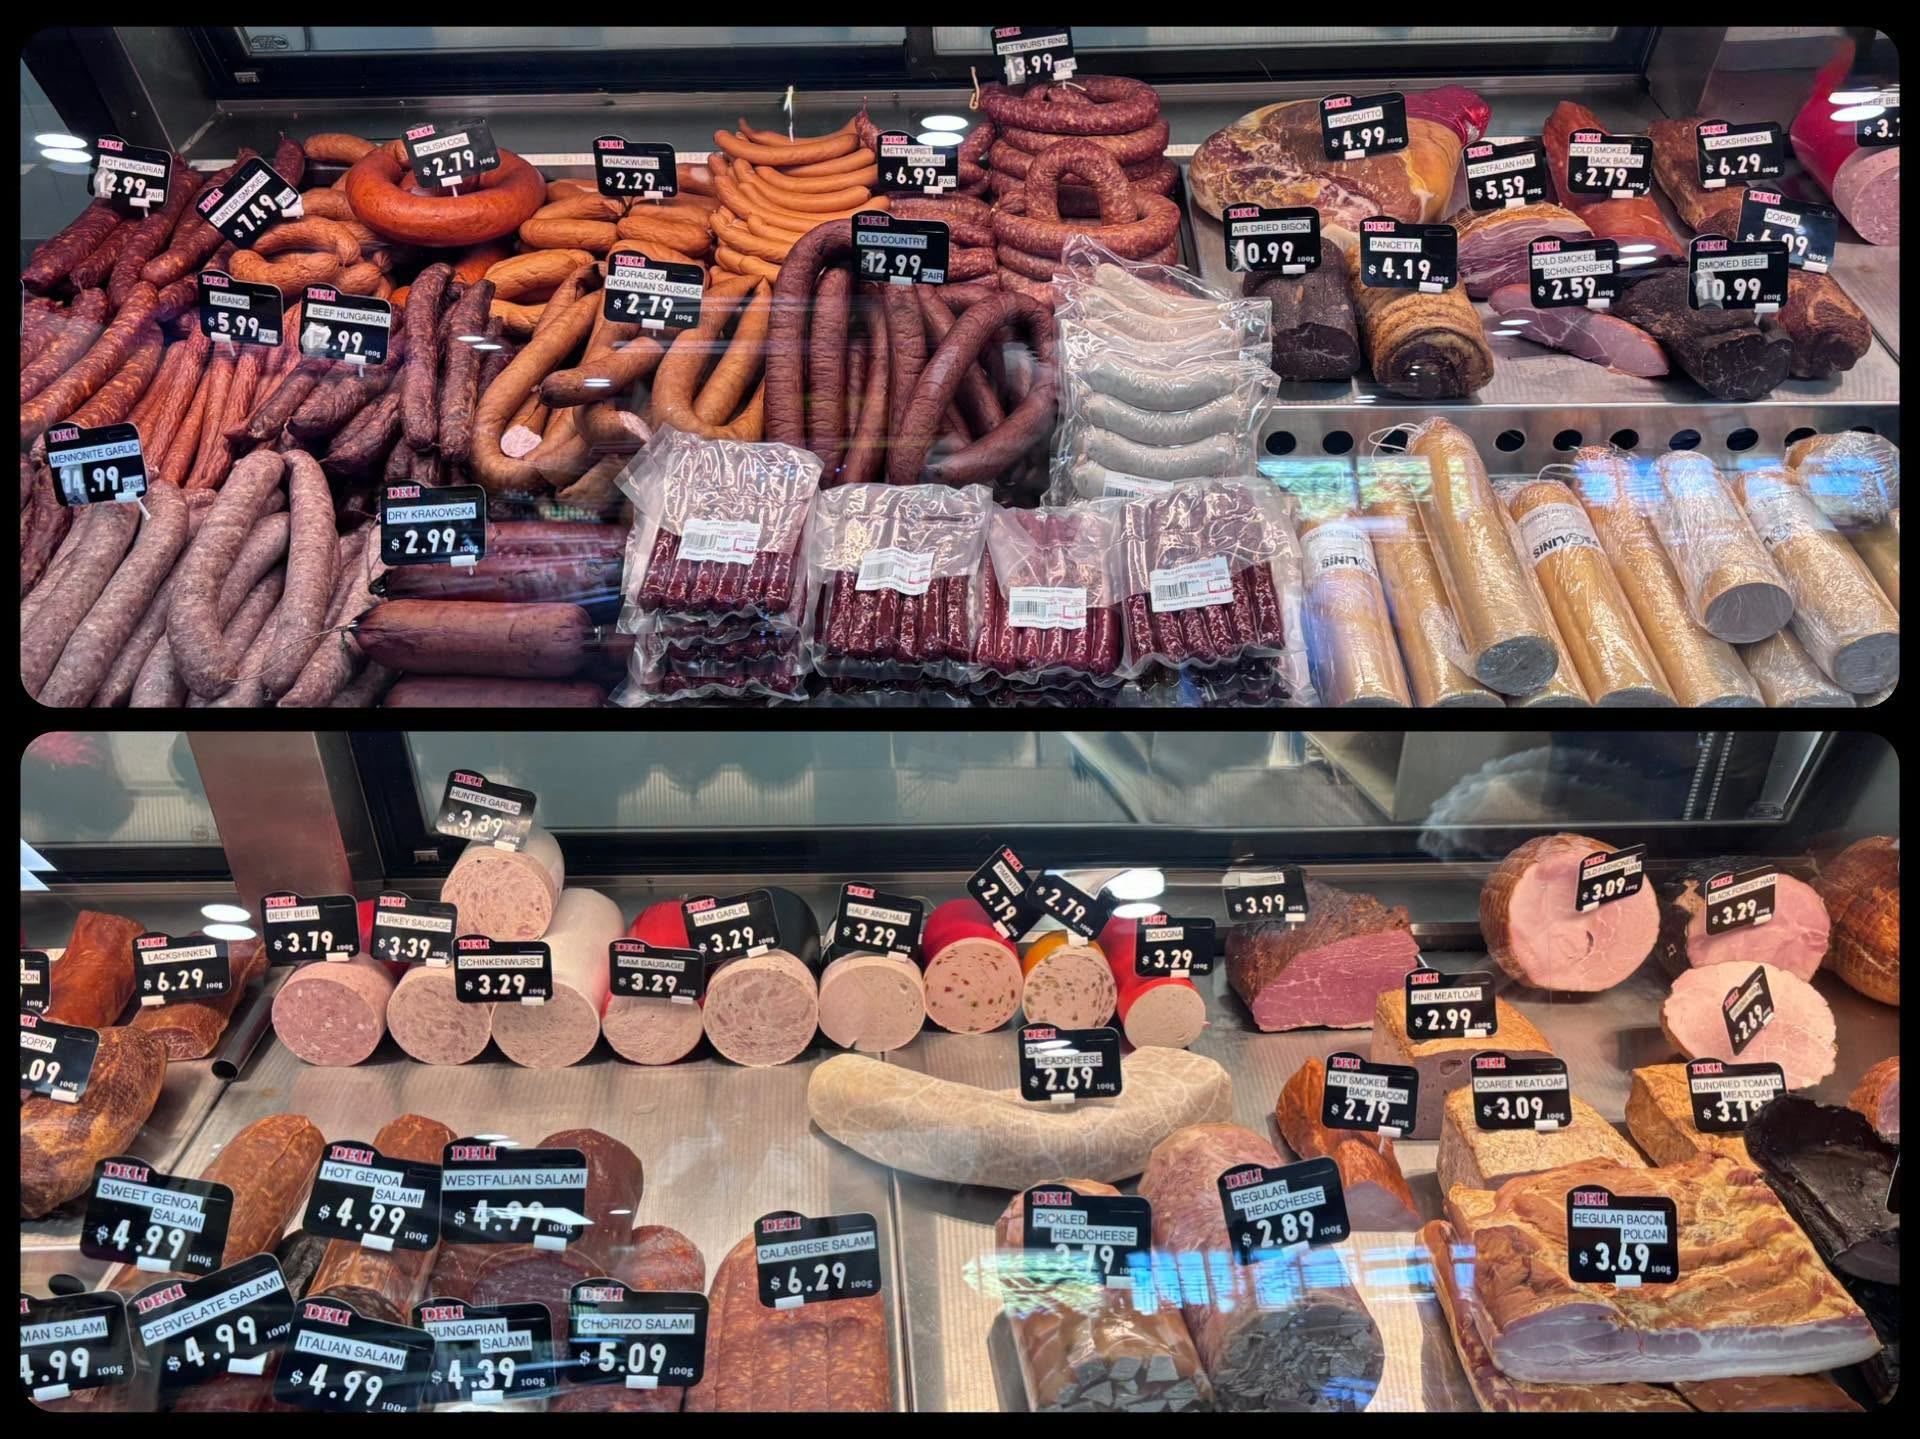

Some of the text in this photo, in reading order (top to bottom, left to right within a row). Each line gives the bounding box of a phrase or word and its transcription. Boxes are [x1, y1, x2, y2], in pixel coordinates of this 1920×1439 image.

[999, 35, 1067, 51] METTWURST RING
[416, 137, 466, 153] POLISH COIL
[1710, 135, 1767, 148] LACKSHINKEN
[604, 158, 658, 167] KNACKWURST
[909, 156, 944, 164] SMOKIES
[1469, 157, 1533, 175] WESTFALIAN HAM
[1590, 156, 1641, 165] BACK BACON
[118, 161, 163, 175] HUNGARIAN
[213, 172, 267, 223] HUNTER SMOKIES
[1766, 210, 1798, 225] COPPA
[1233, 223, 1310, 233] AIR DRIED BISON
[859, 234, 926, 245] OLD COUNTRY
[1371, 241, 1420, 249] PANCETTA
[1533, 253, 1596, 267] COLD SMOKED
[1699, 259, 1766, 270] SMOKED BEEF
[617, 270, 666, 281] GORALSKA
[922, 271, 943, 281] PAIR
[607, 279, 700, 295] UKRAINIAN SAUSAGE
[211, 294, 249, 307] KABANOS
[312, 308, 387, 324] BEEF HUNGARIAN
[260, 330, 277, 341] PAIR
[51, 443, 138, 465] MENNONITE GARLIC
[124, 479, 143, 490] PAIR
[388, 507, 474, 520] DRY KRAKOWSKA
[452, 789, 520, 812] HUNTER GARLIC
[1710, 877, 1775, 903] BLACK FOREST HAM
[268, 910, 318, 920] BEEF BEER
[696, 905, 748, 924] HAM GARLIC
[848, 906, 909, 922] HALF AND HALF
[378, 915, 450, 930] TURKEY SAUSAGE
[148, 948, 211, 961] LACKSHINKEN
[460, 958, 541, 966] SCHINKENWURST
[619, 957, 683, 970] HAM SAUSAGE
[1414, 990, 1479, 1001] FINE MEATLOAF
[21, 1035, 53, 1050] COPPA
[1037, 1056, 1102, 1064] HEADCHEESE
[1329, 1074, 1387, 1087] HOT SMOKED
[1476, 1078, 1564, 1089] COARSE MEATLOAF
[1693, 1078, 1781, 1091] SUNDRIED TOMATO
[1350, 1088, 1406, 1101] BACK BACON
[1723, 1090, 1773, 1099] MEATLOAF
[330, 1146, 374, 1165] DELI
[452, 1145, 496, 1161] DELI
[104, 1162, 151, 1182] DELI
[324, 1165, 399, 1188] HOT GENOA
[445, 1171, 584, 1186] WESTFALIAN SALAMI
[1225, 1168, 1263, 1189] DELI
[100, 1182, 199, 1212] SWEET GENOA
[375, 1189, 422, 1205] SALAMI
[1033, 1192, 1072, 1206] DELI
[1234, 1184, 1287, 1206] REGULAR
[1574, 1192, 1608, 1206] DELI
[1246, 1191, 1324, 1216] HEADCHEESE
[153, 1208, 202, 1228] SALAMI
[762, 1217, 802, 1233] DELI
[1035, 1212, 1086, 1226] PICKLED
[1574, 1213, 1664, 1226] REGULAR BACON
[1054, 1228, 1135, 1242] HEADCHEESE
[1320, 1224, 1342, 1235] 100g
[1624, 1228, 1667, 1241] POLCAN
[404, 1231, 428, 1243] 100g
[760, 1235, 874, 1260] CALABRESE SALAMI
[187, 1252, 212, 1267] 100g
[850, 1279, 873, 1288] 100g
[135, 1284, 187, 1314] DELI
[580, 1287, 624, 1302] DELI
[143, 1275, 281, 1343] CERVELATE SALAMI
[303, 1303, 351, 1326] DELI
[421, 1305, 464, 1321] DELI
[53, 1319, 106, 1337] SALAMI
[429, 1321, 505, 1339] HUNGARIAN
[582, 1317, 693, 1330] CHORIZO SALAMI
[482, 1337, 530, 1351] SALAMI
[299, 1336, 404, 1367] ITALIAN SALAMI
[96, 1364, 124, 1376] 100g
[669, 1367, 694, 1377] 100g
[520, 1377, 545, 1387] 100g
